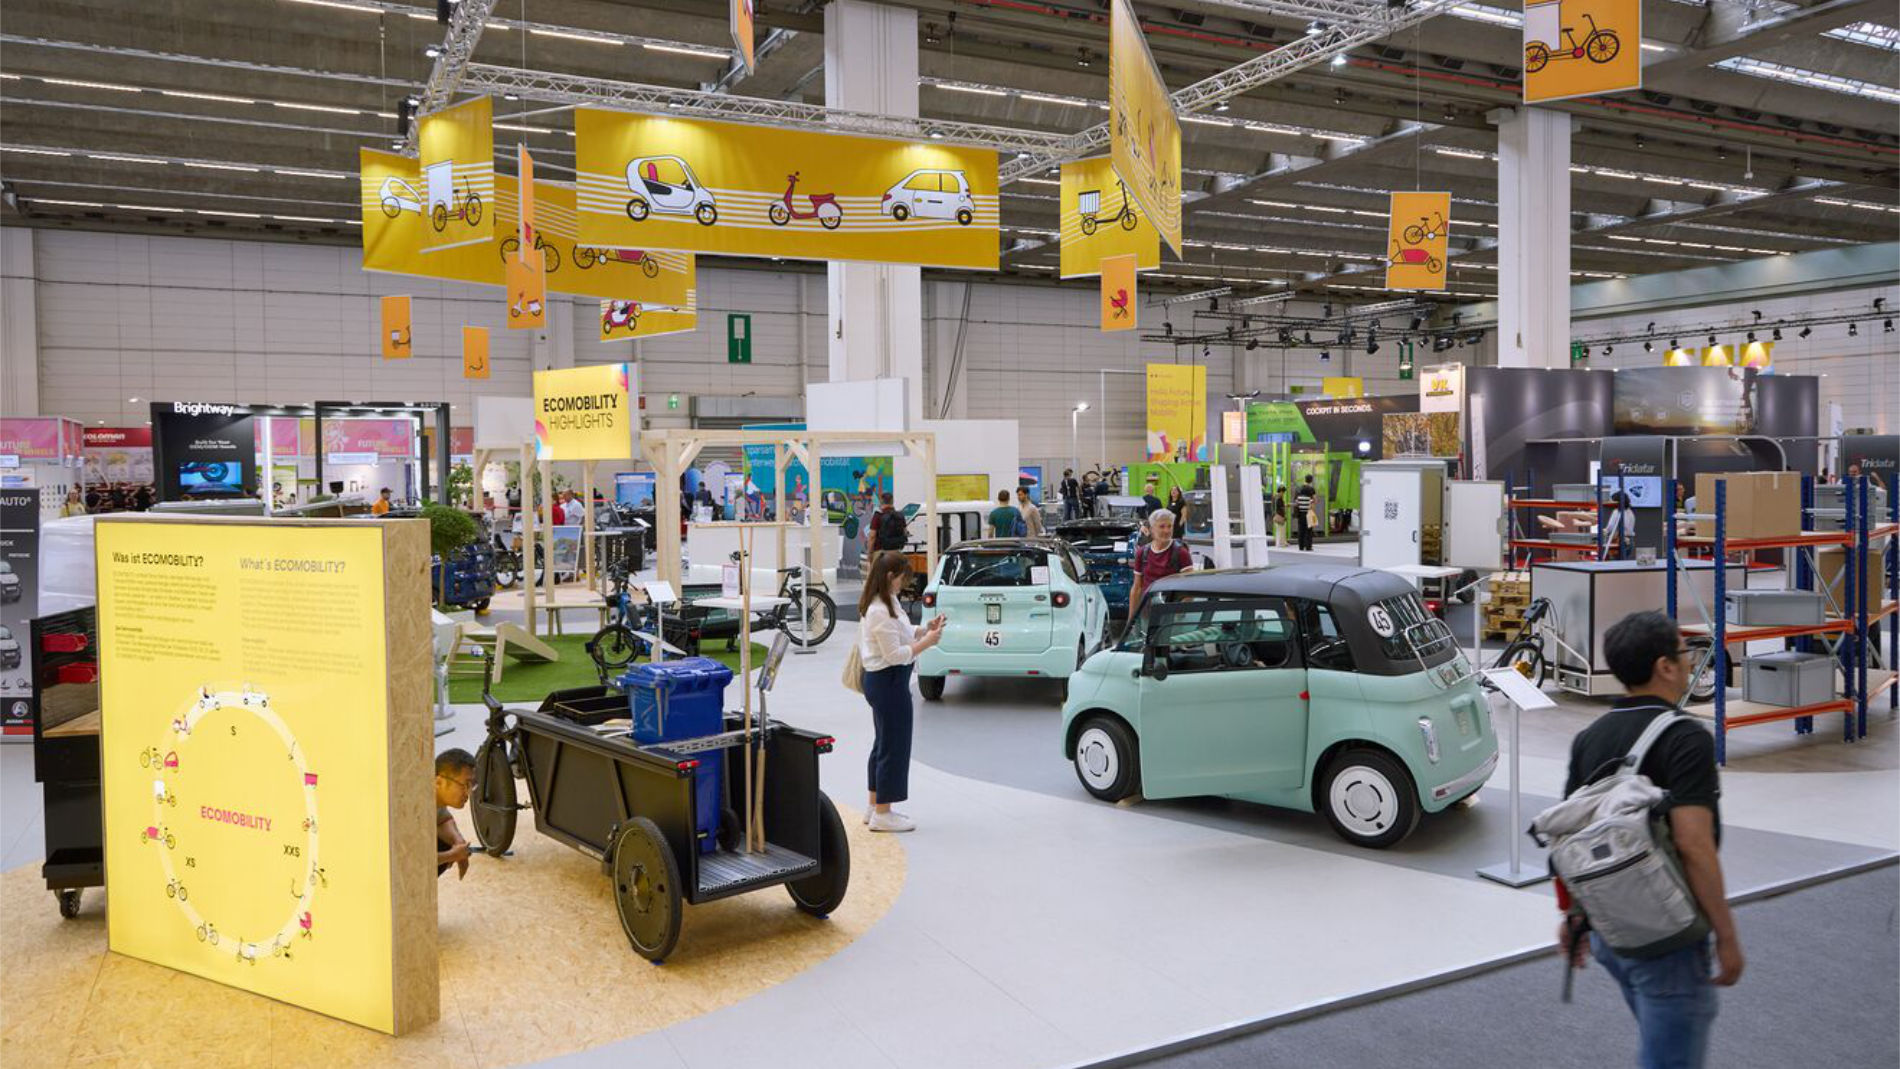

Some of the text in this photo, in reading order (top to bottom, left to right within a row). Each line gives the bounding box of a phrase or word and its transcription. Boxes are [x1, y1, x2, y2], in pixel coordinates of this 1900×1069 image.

[174, 401, 234, 416] Brightway
[543, 394, 618, 412] ECOMOBILITY
[1306, 404, 1373, 415] COCKPIT IN SECONDS.
[550, 413, 613, 429] HIGHLIGHTS
[1619, 463, 1656, 474] Tridata
[112, 552, 204, 567] Was ist ECOMOBILITY?
[274, 559, 346, 574] ECOMOBILITY?
[1372, 610, 1391, 632] 45
[985, 631, 999, 646] 45
[231, 726, 236, 736] S
[201, 806, 272, 832] ECOMOBILITY
[284, 845, 300, 858] XXS
[186, 857, 196, 868] XS
